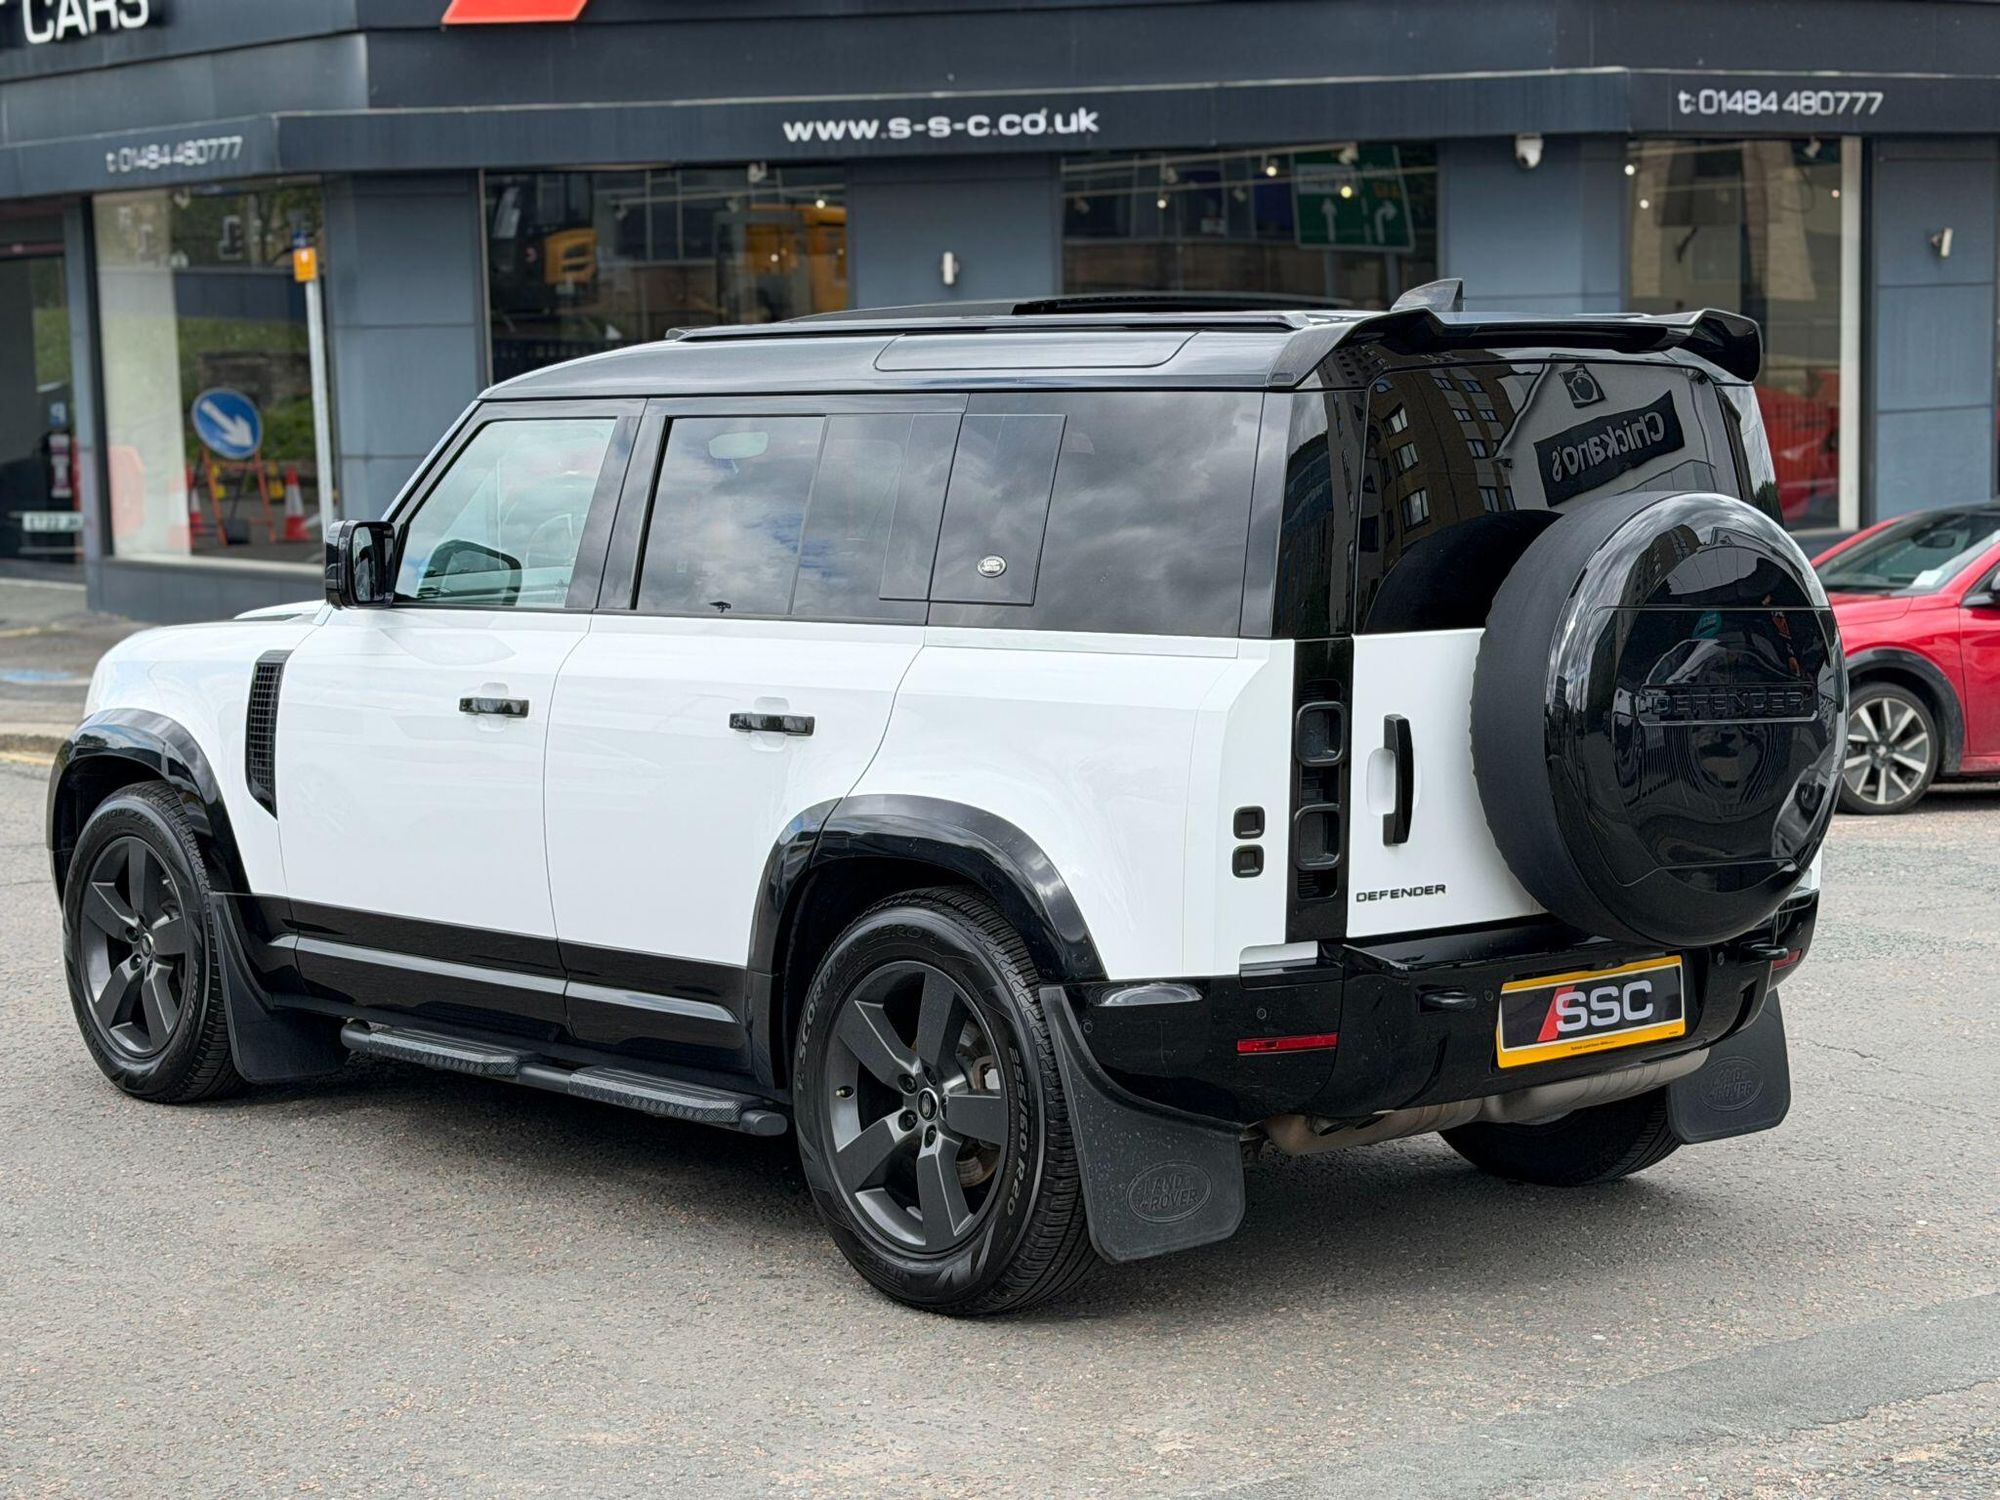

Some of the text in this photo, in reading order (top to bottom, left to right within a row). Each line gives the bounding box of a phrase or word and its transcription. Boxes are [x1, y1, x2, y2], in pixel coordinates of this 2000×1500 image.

[1782, 90, 1884, 115] 480777
[783, 107, 1098, 142] www.s-s-c.co.uk
[1652, 692, 1805, 714] DEFENDER
[1356, 884, 1446, 902] DEFENDER
[1555, 979, 1654, 1032] SSC
[1007, 1157, 1026, 1217] R20
